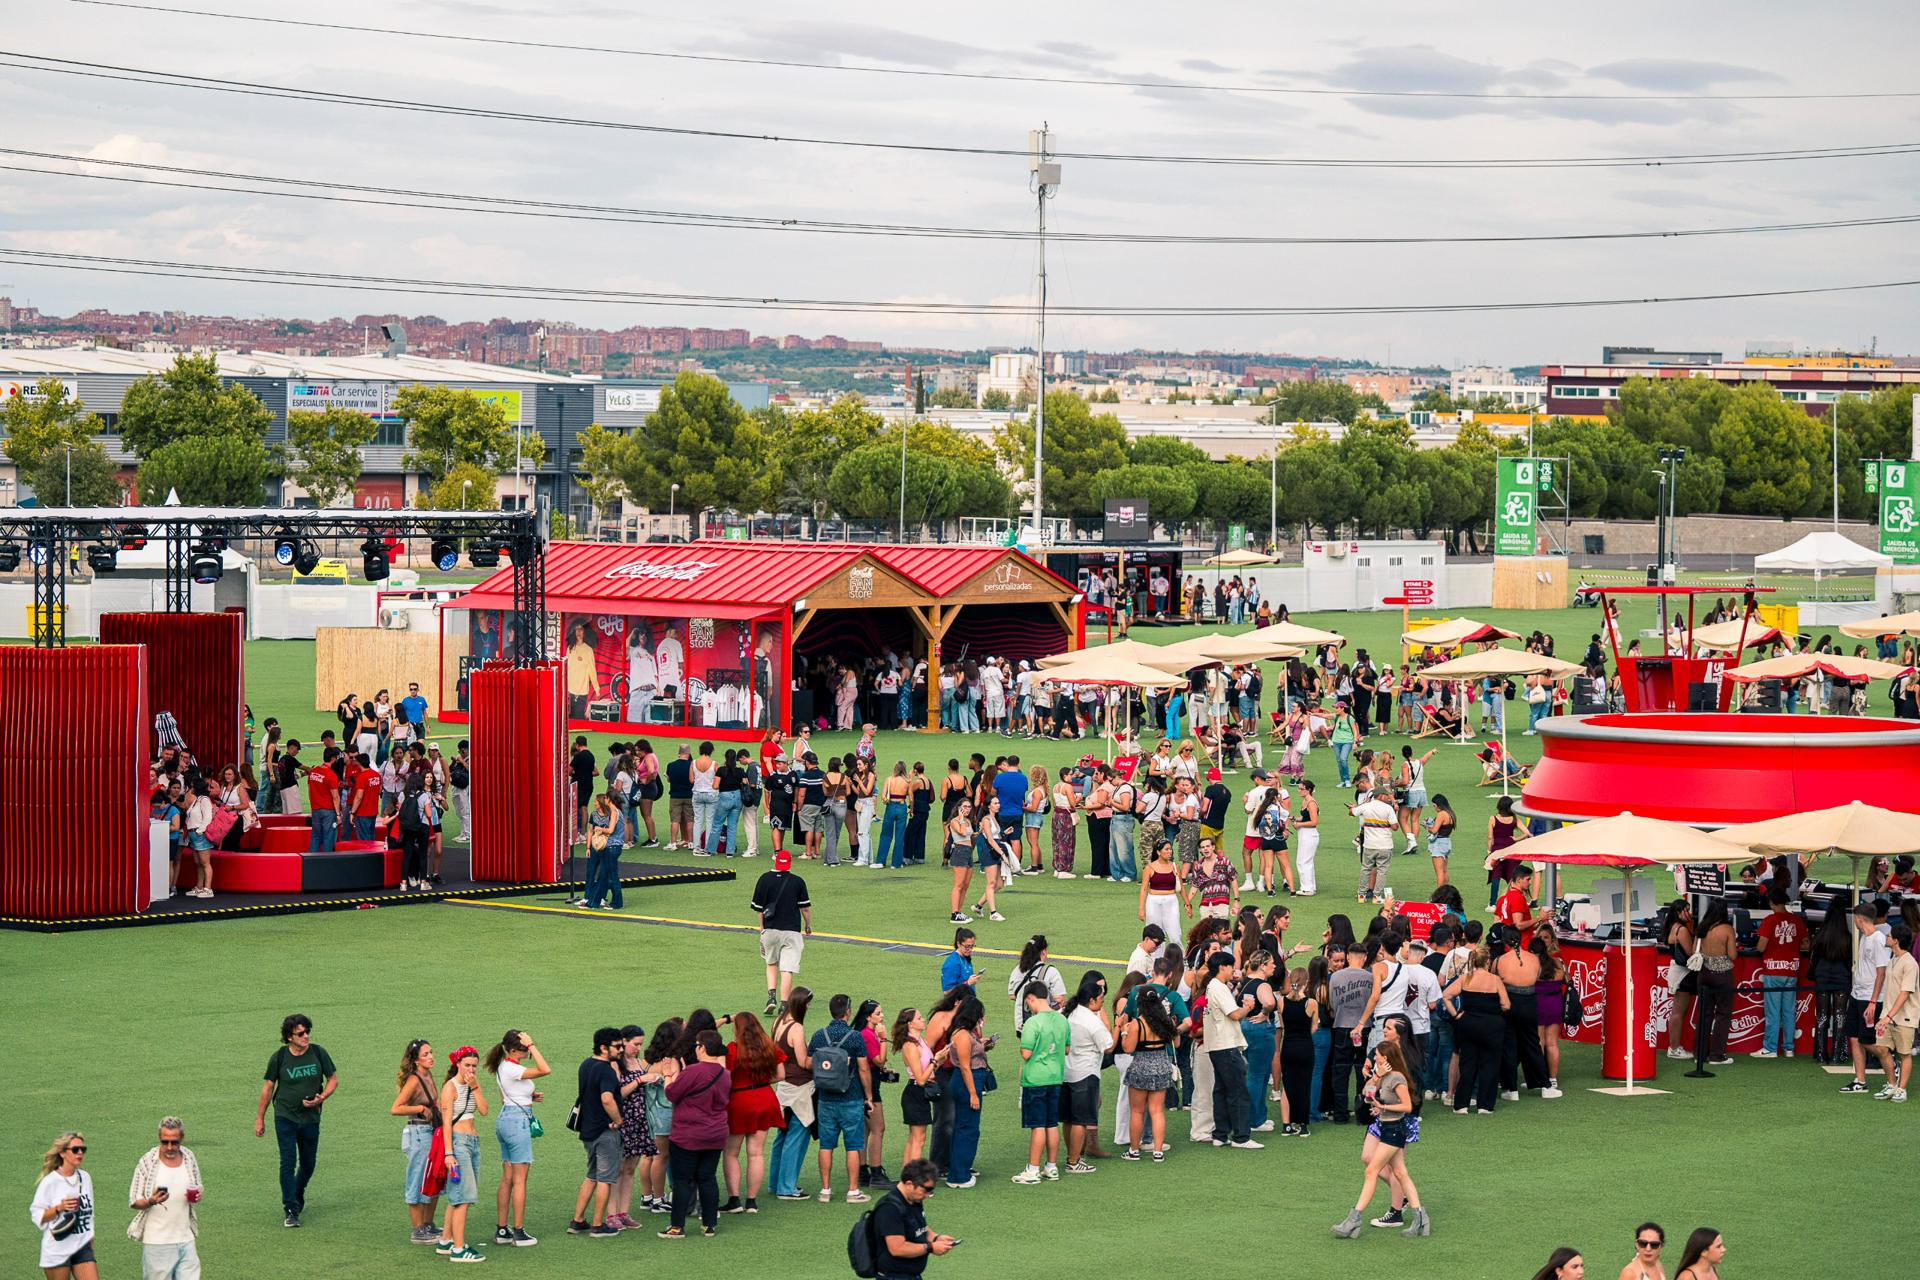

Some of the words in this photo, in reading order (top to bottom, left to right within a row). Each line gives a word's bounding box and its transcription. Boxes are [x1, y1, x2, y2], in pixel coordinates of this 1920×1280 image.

[331, 386, 345, 397] Car
[347, 386, 378, 397] service
[292, 400, 335, 408] ESPECIALISTS
[335, 400, 344, 408] EN
[365, 400, 378, 408] MINI
[1521, 467, 1529, 480] 6
[1891, 469, 1900, 483] 6
[849, 578, 873, 591] FAN
[984, 582, 1032, 592] personalizadas
[849, 591, 873, 599] store
[689, 627, 714, 640] FAN
[689, 640, 714, 648] store
[1333, 986, 1346, 997] The
[1347, 979, 1373, 992] future
[1731, 1015, 1760, 1032] Celia
[286, 1063, 317, 1079] VANS
